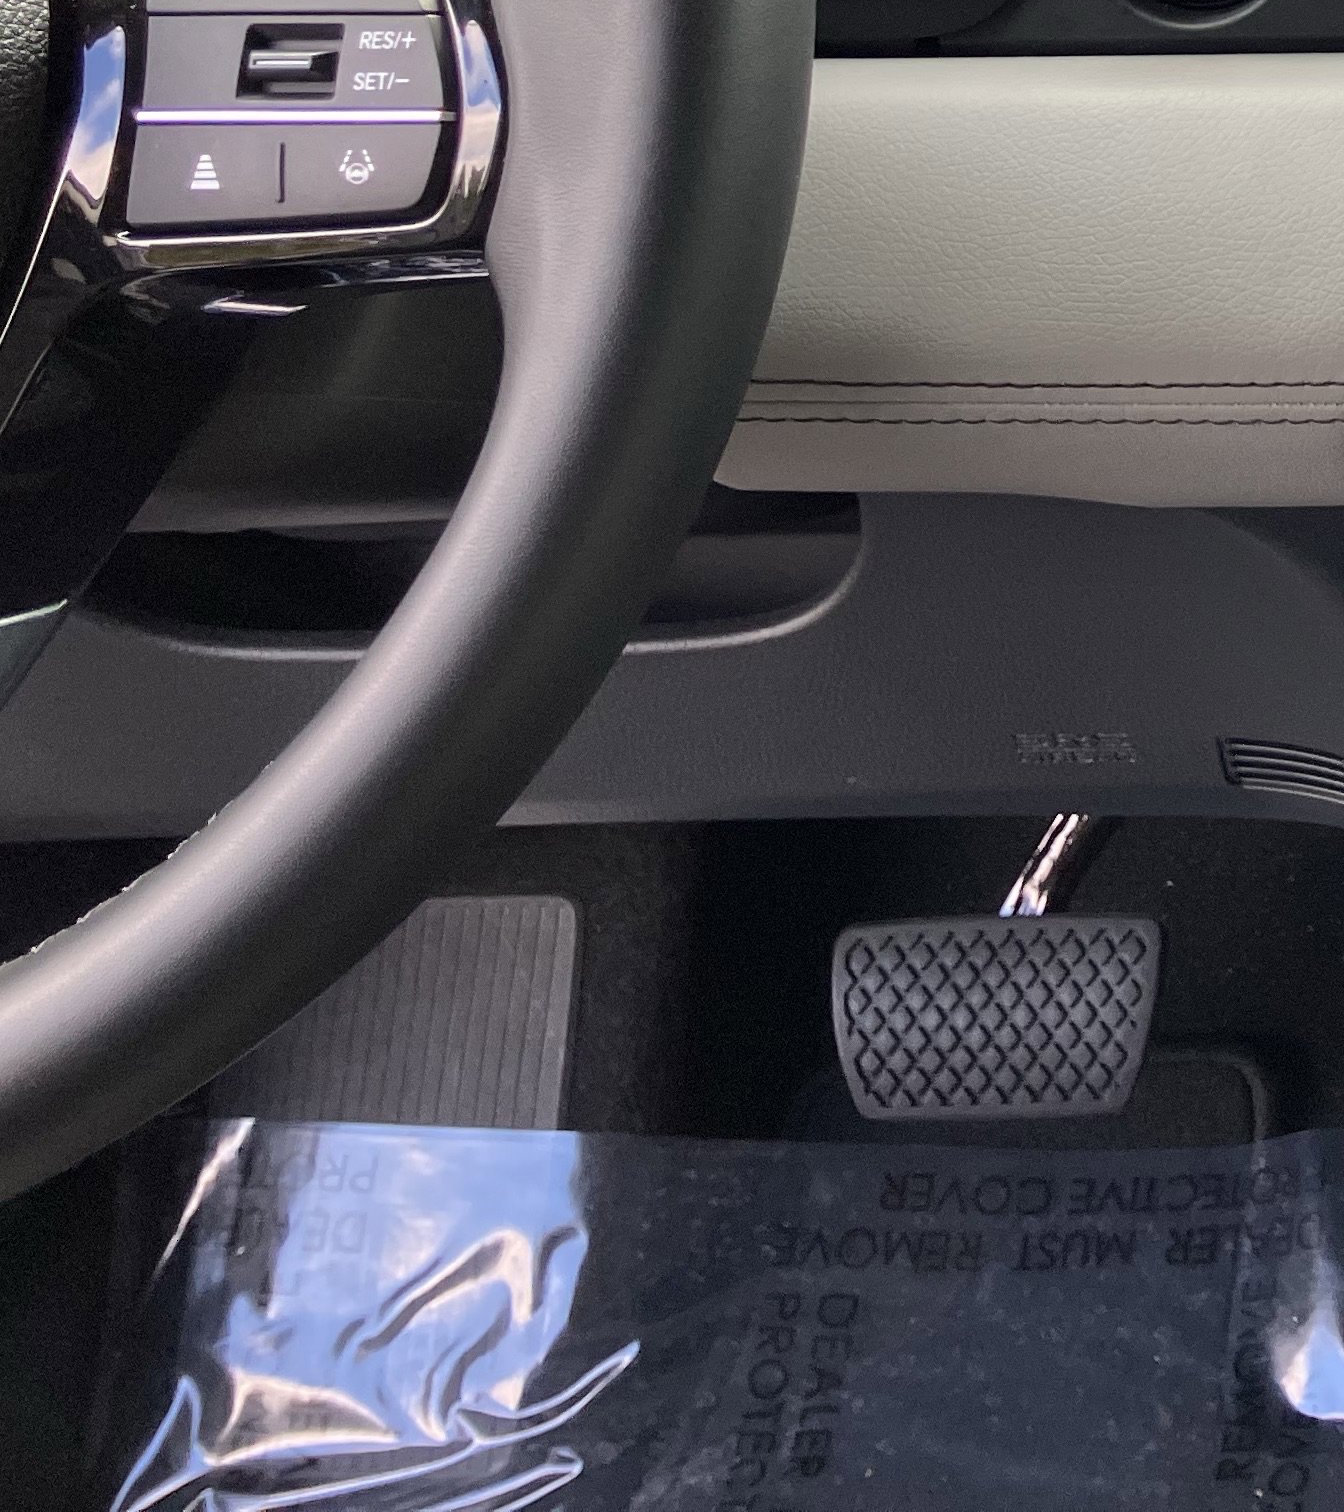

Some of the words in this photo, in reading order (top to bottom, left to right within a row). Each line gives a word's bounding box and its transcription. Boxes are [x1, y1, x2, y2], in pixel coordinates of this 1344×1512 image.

[358, 30, 417, 50] RES/+
[352, 71, 410, 91] SET/-
[879, 1171, 1053, 1216] COVER
[1066, 1166, 1322, 1216] ROTECTIVE
[771, 1226, 985, 1272] REMOVE
[1012, 1226, 1138, 1272] MUST
